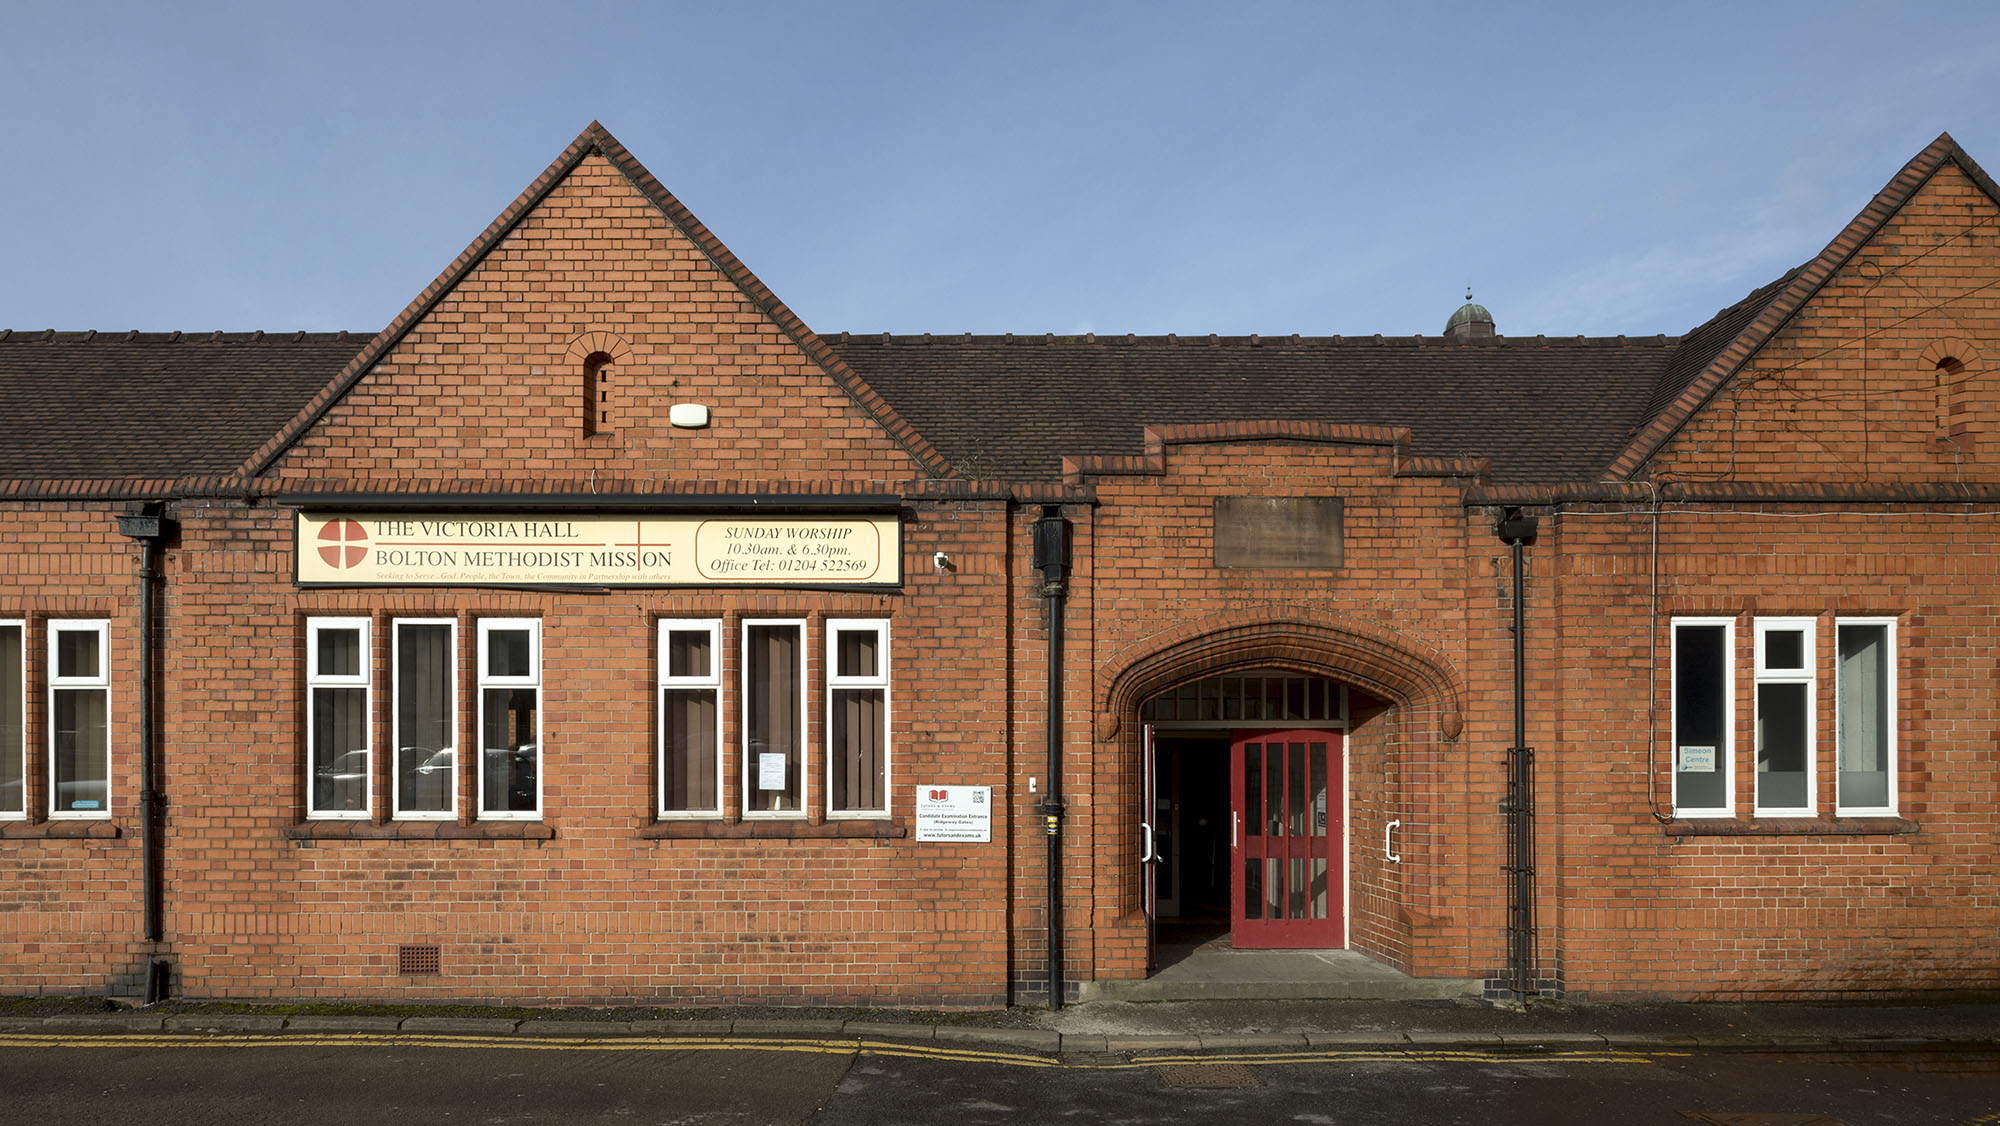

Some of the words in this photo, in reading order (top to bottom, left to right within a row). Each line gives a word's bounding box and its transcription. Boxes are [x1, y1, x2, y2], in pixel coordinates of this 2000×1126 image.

[374, 520, 415, 536] THE
[421, 521, 519, 538] VICTORIA
[524, 522, 579, 538] HALL
[724, 527, 782, 539] SUNDAY
[786, 528, 852, 540] WORSHIP
[726, 543, 782, 556] 10.30am.
[786, 544, 797, 556] &
[802, 544, 852, 558] 6.30pm.
[376, 550, 457, 566] BOLTON
[464, 551, 584, 567] METHODIST
[590, 552, 672, 568] MISSION
[710, 558, 748, 574] Office
[752, 559, 775, 572] Tel:
[778, 559, 816, 572] 01204
[820, 559, 867, 572] 522569
[376, 572, 404, 581] Seeking
[488, 572, 500, 580] the
[524, 572, 536, 581] the
[537, 573, 578, 582] Community
[580, 573, 587, 581] in
[588, 573, 630, 582] Partnership
[632, 573, 647, 582] with
[648, 573, 672, 582] others
